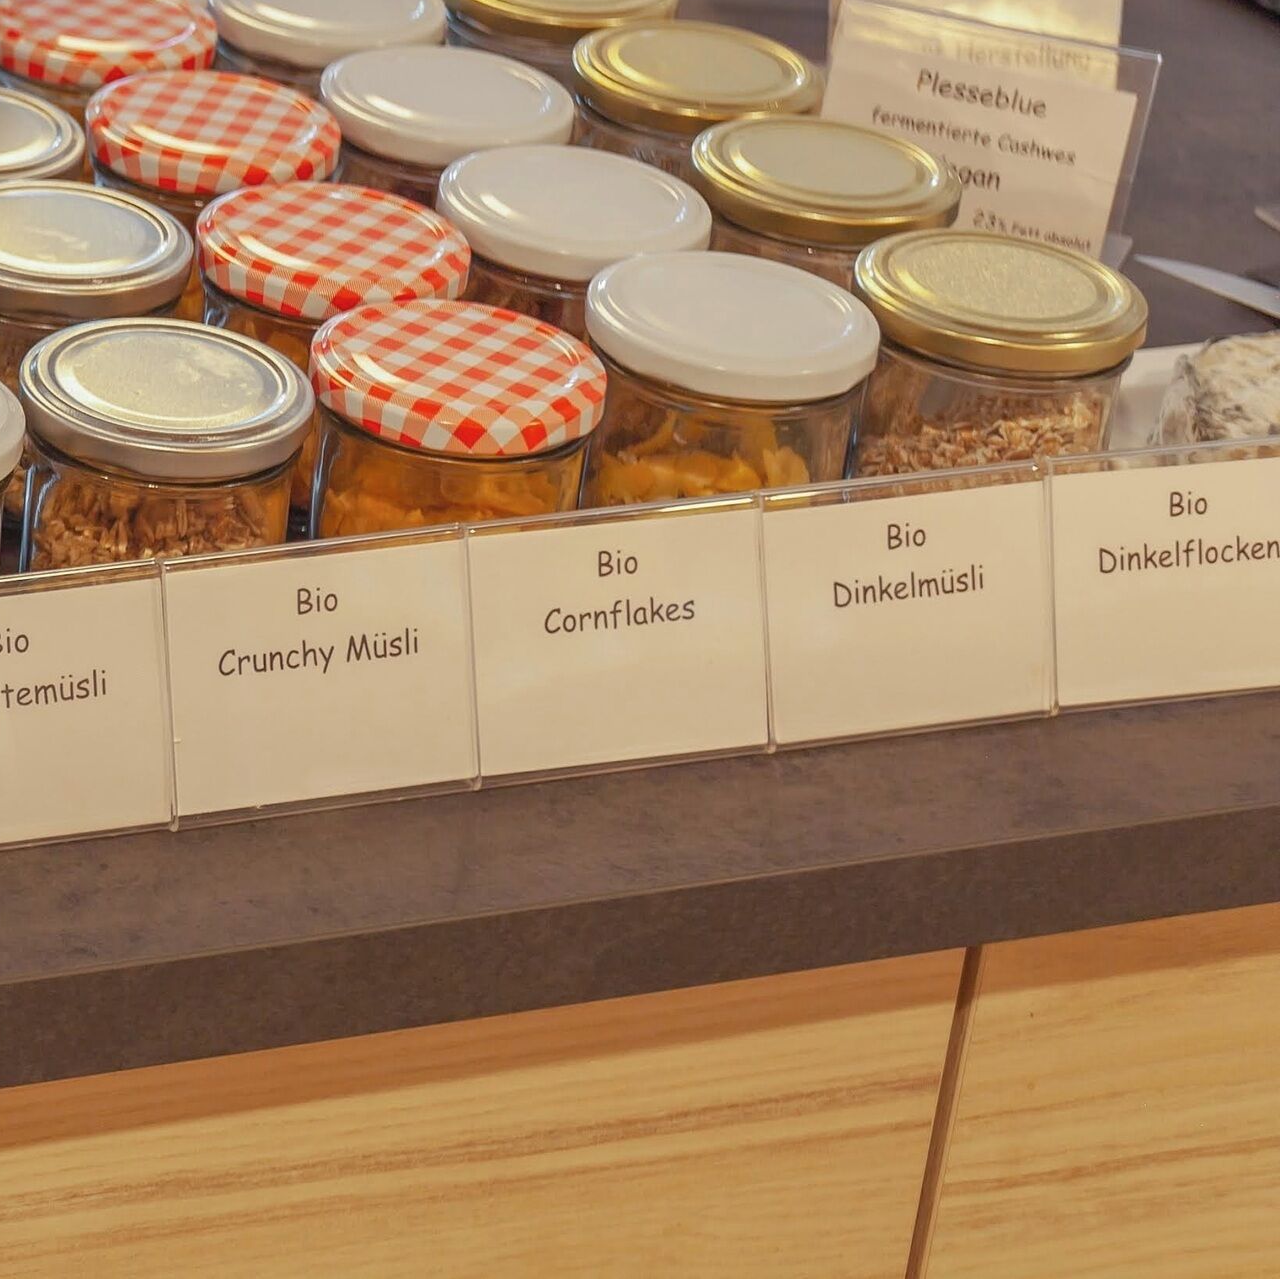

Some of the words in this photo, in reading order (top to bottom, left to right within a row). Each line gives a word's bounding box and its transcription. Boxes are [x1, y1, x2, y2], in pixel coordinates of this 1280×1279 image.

[917, 69, 1047, 119] Plesseblue
[872, 105, 991, 147] fermentierte
[1169, 491, 1208, 519] Bio
[886, 522, 927, 551] Bio
[1098, 535, 1280, 575] Dinkelflocken
[597, 549, 639, 578] Bio
[296, 586, 339, 616] Bio
[832, 564, 985, 609] Dinkelmüsli
[544, 596, 696, 636] Cornflakes
[217, 638, 336, 678] Crunchy
[346, 627, 419, 664] Müsli
